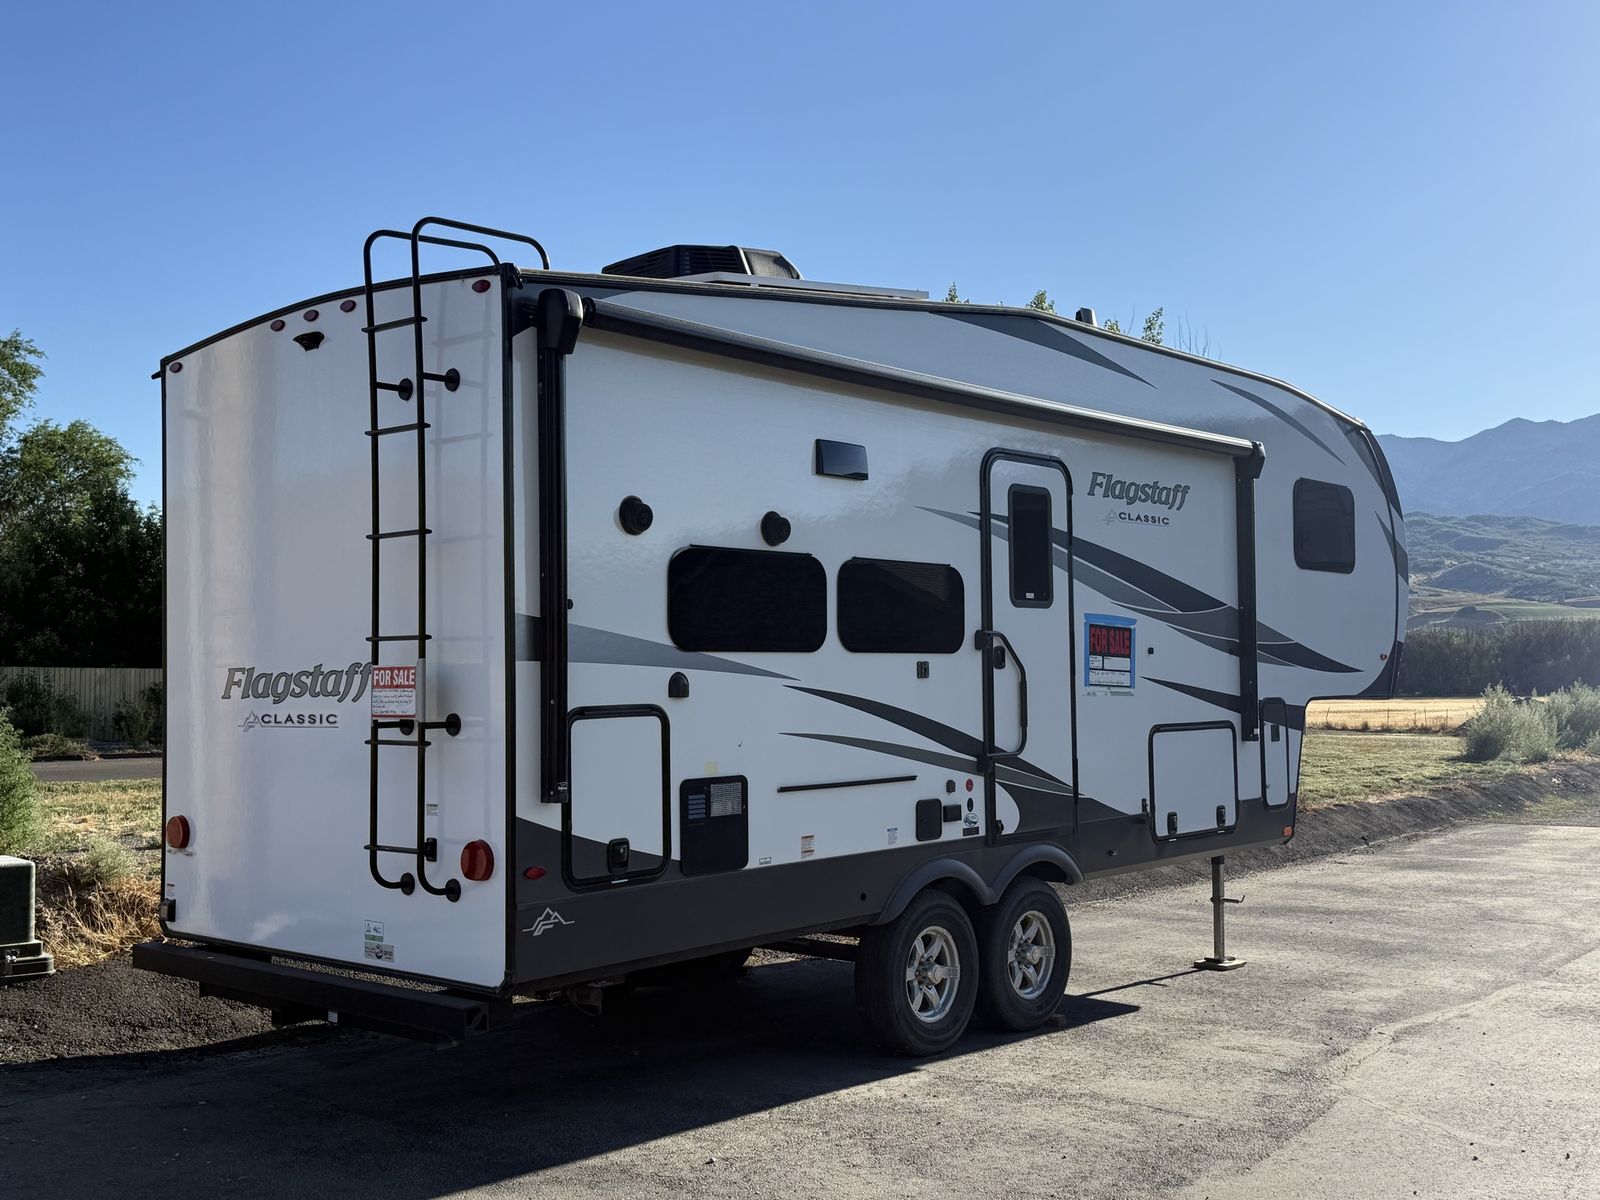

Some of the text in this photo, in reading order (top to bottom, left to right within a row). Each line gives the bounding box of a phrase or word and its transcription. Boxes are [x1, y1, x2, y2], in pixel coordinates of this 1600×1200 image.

[1087, 471, 1190, 511] Flagstaff
[1118, 511, 1170, 525] CLASSIC
[1090, 627, 1130, 654] FOR SALE
[221, 662, 372, 704] Flagstaff
[373, 669, 415, 686] FOR SALE
[261, 713, 338, 725] CLASSIC
